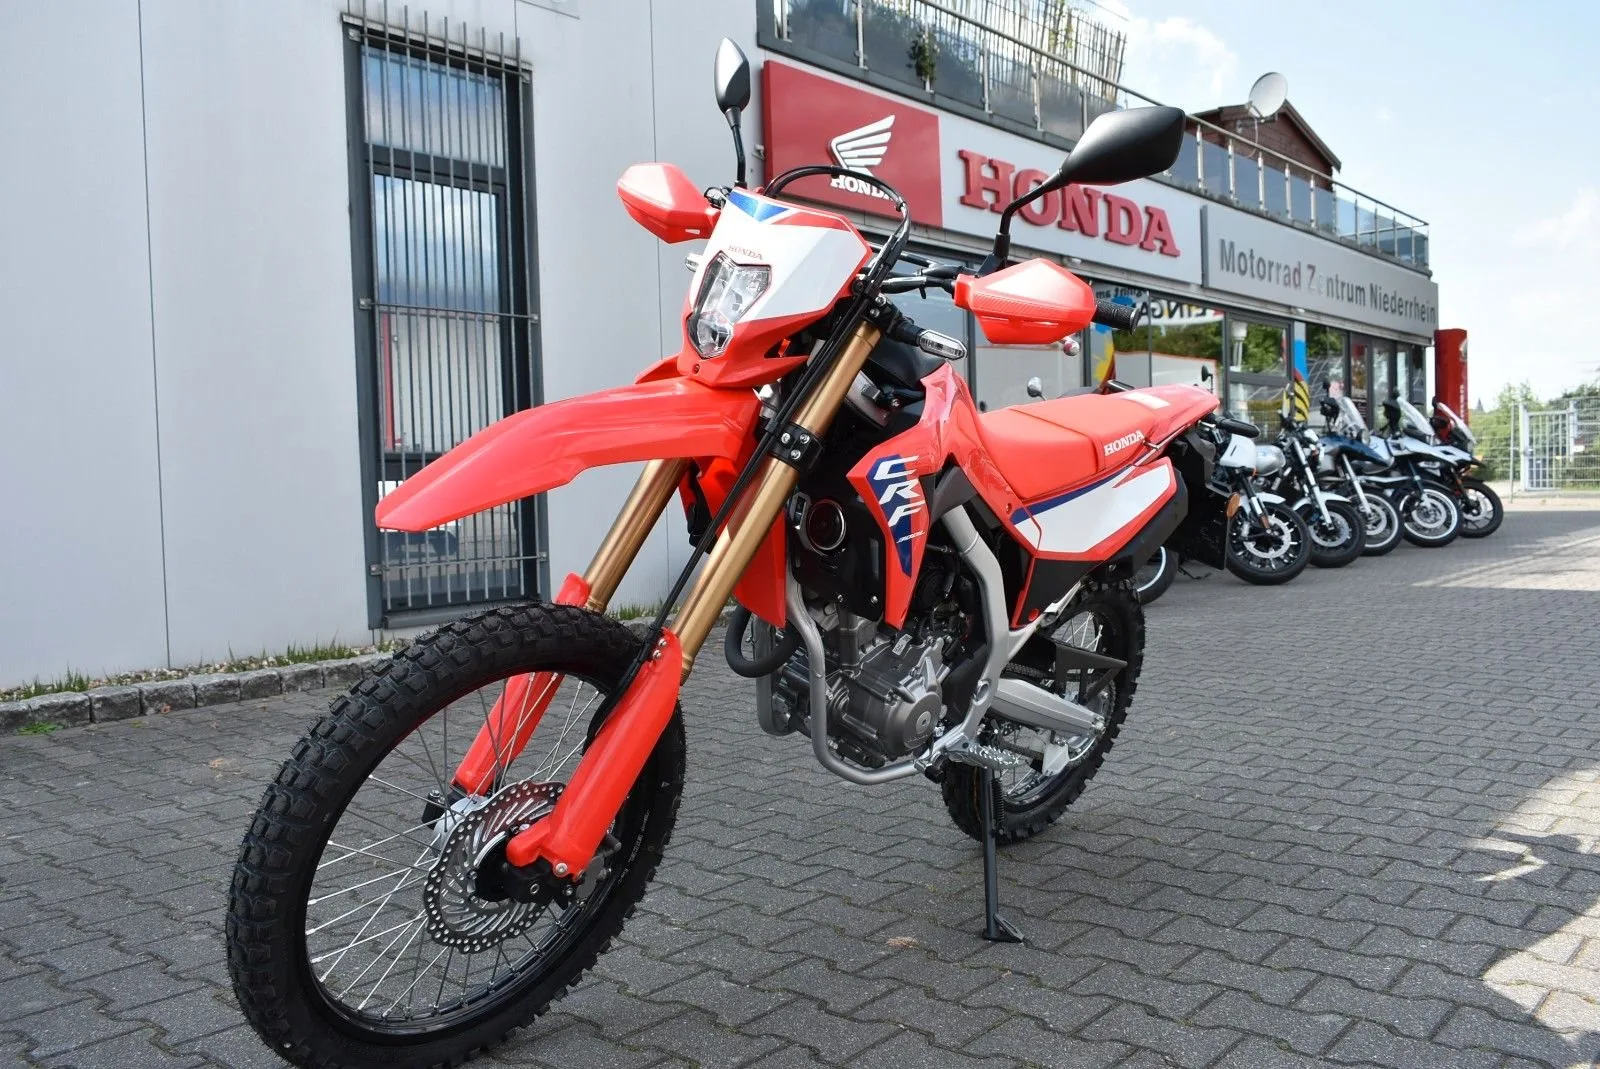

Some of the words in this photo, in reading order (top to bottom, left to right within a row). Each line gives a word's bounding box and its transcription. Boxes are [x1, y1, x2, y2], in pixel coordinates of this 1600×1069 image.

[958, 149, 1181, 257] HONDA
[1219, 238, 1301, 290] Motorrad
[1369, 282, 1436, 324] Niederrhein
[1103, 429, 1145, 457] HONDA
[873, 455, 926, 528] CRF
